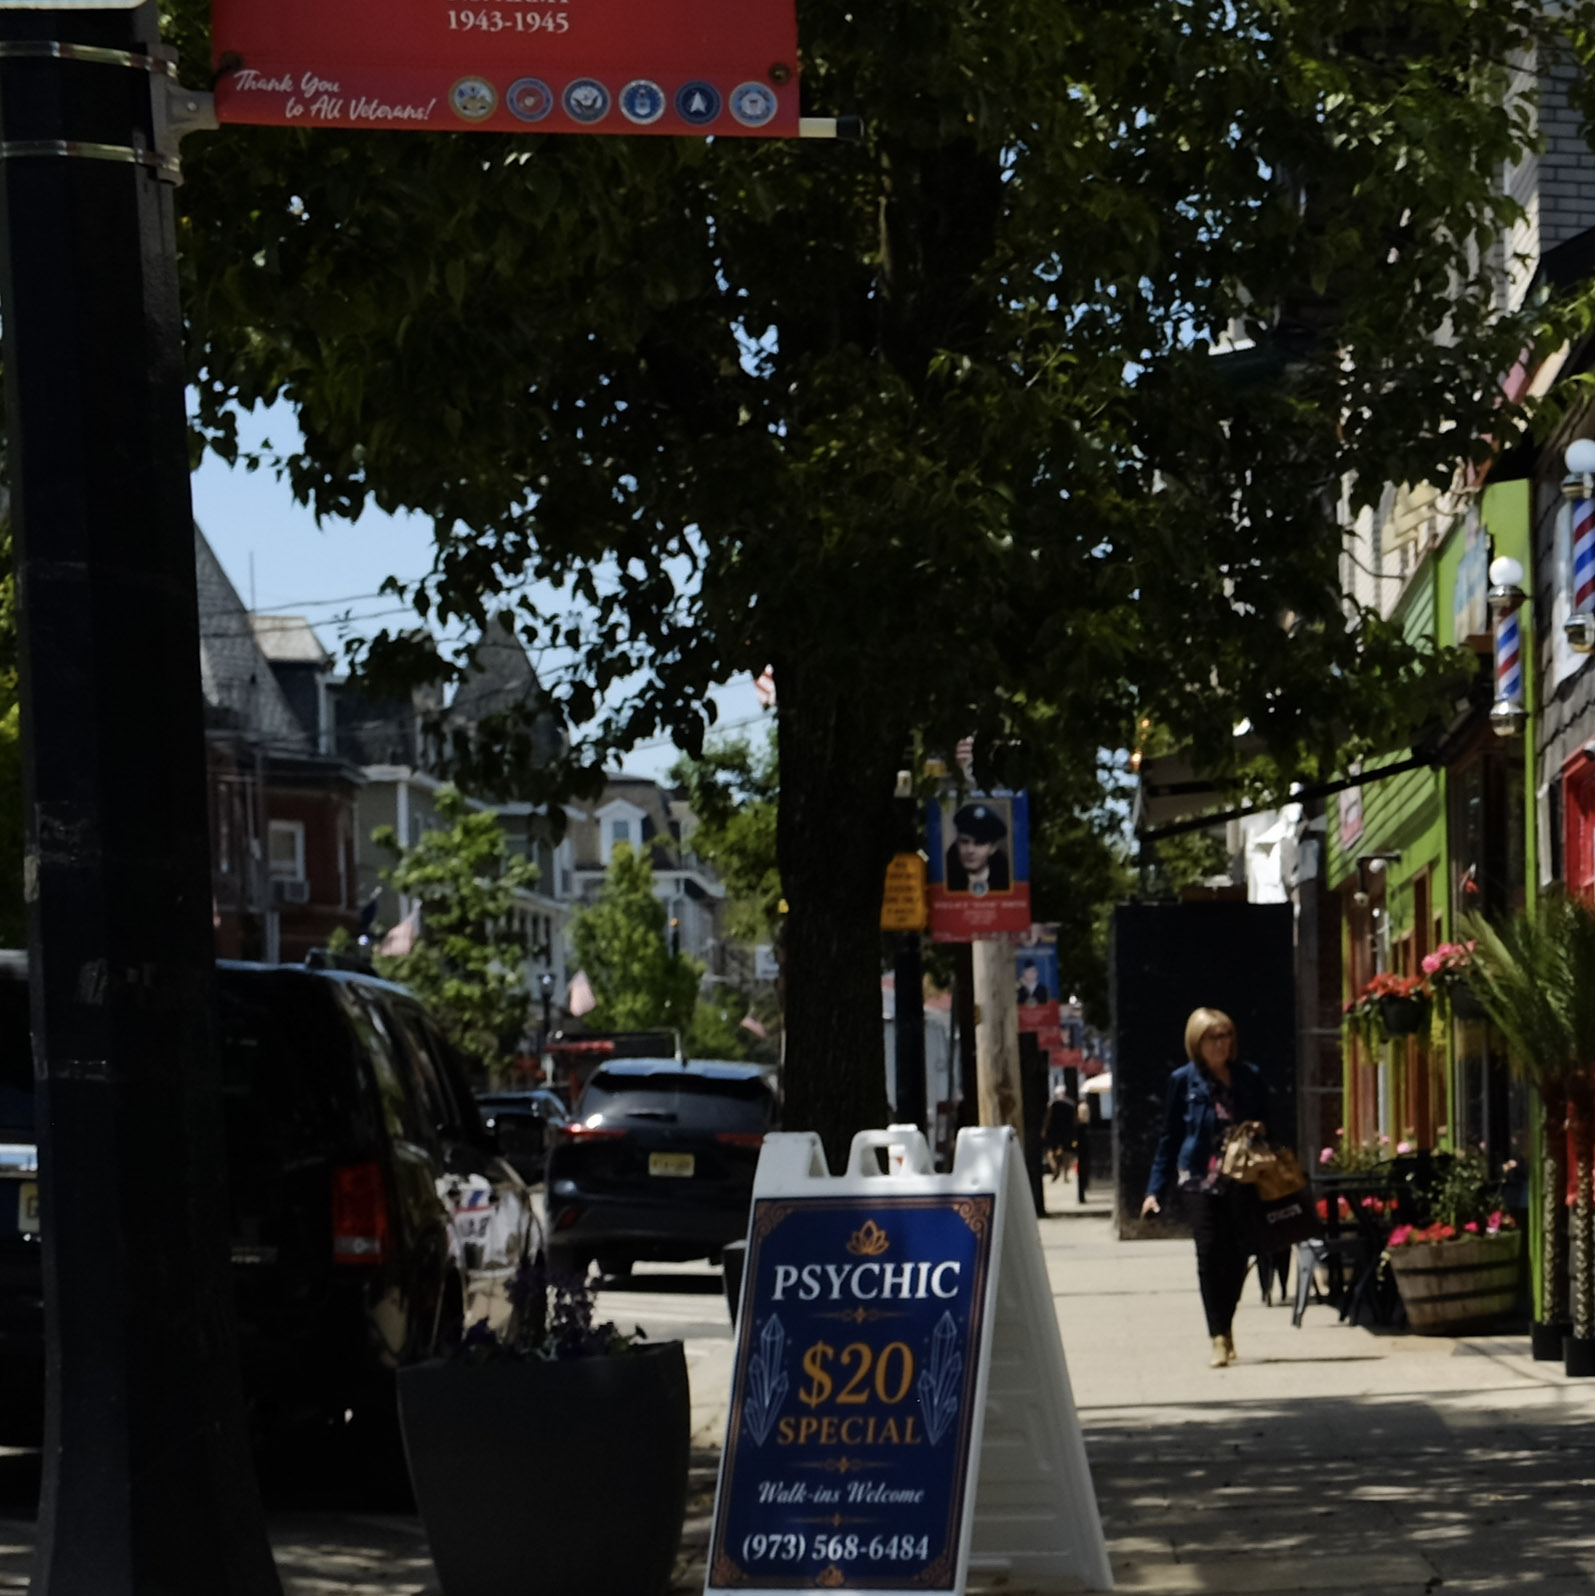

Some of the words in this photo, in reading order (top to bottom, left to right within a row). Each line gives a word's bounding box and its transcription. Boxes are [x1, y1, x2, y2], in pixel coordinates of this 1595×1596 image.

[447, 9, 569, 34] 1943-1945
[234, 69, 293, 92] Thank
[300, 72, 340, 98] You
[285, 97, 303, 119] to
[310, 95, 344, 120] All
[350, 97, 437, 121] Veterans!
[771, 1261, 961, 1300] PSYCHIC
[798, 1340, 914, 1409] $20
[776, 1416, 922, 1445] SPECIAL
[758, 1481, 841, 1504] Walk-ins
[847, 1481, 925, 1504] Welcome
[742, 1533, 807, 1562] (973)
[812, 1534, 930, 1561] 568-6484
